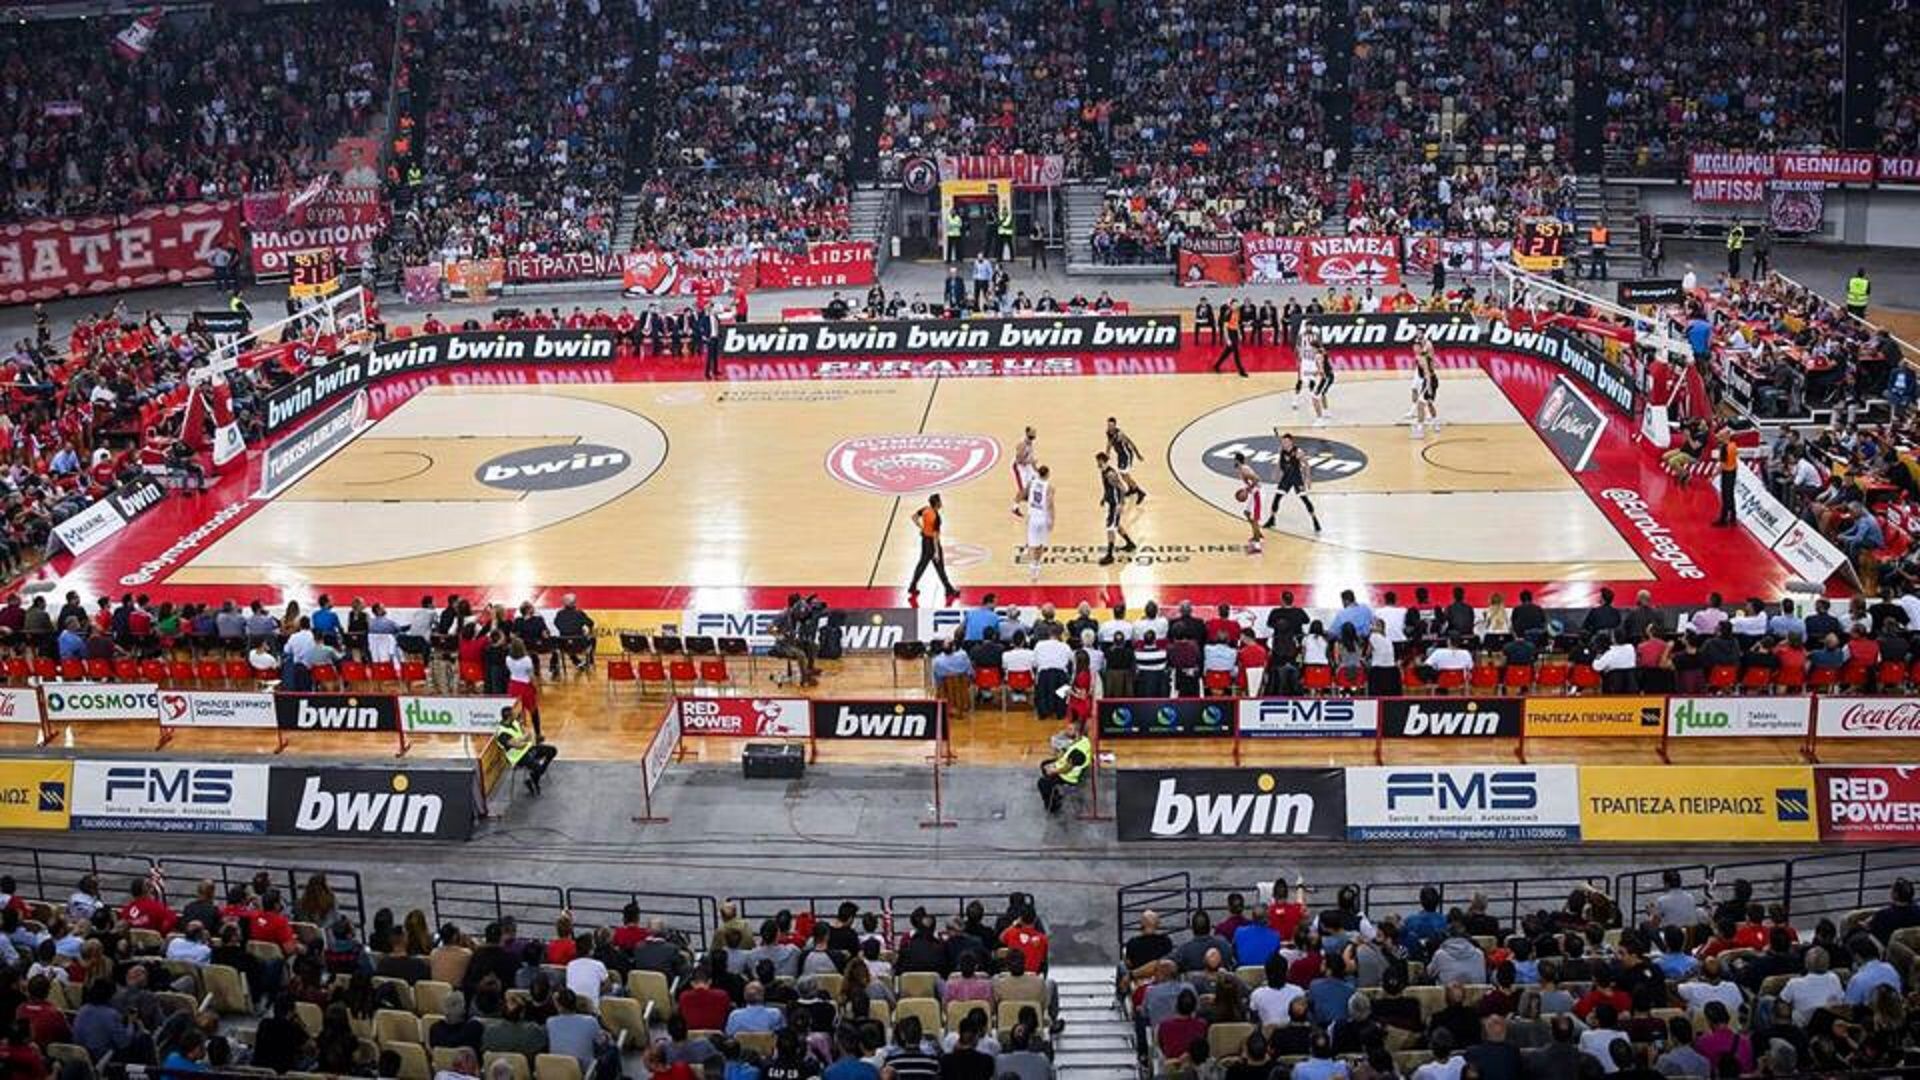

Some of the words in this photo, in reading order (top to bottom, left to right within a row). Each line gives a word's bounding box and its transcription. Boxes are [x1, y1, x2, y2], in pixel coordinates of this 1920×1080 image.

[1784, 157, 1873, 175] ΛΕΩΝΙΔΙΟ
[1693, 180, 1764, 201] AMFISSA
[1309, 238, 1396, 257] NEMEA
[724, 327, 810, 352] bwin
[815, 325, 898, 350] bwin
[907, 323, 990, 348] bwin
[1000, 321, 1083, 347] bwin
[1092, 320, 1178, 345] bwin
[1393, 316, 1481, 343] bwin
[1490, 321, 1559, 358] bwin
[1561, 338, 1596, 383] bwin
[1597, 363, 1633, 411] bwin
[269, 385, 313, 429] bwin
[315, 359, 361, 400] bwin
[367, 337, 438, 377] bwin
[447, 334, 525, 361] bwin
[533, 334, 612, 359] bwin
[482, 451, 624, 482] bwin
[116, 481, 162, 518] bwin
[1600, 486, 1706, 581] @EuroLeague
[67, 693, 159, 710] COSMOTE
[297, 697, 379, 728] bwin
[682, 701, 720, 715] RED
[1259, 701, 1355, 722] FMS
[683, 715, 742, 728] POWER
[835, 703, 927, 737] bwin
[1403, 701, 1500, 735] bwin
[1527, 713, 1580, 723] ΤΡΑΠΕΖΑ
[106, 767, 233, 804] FMS
[1386, 771, 1538, 810] FMS
[1829, 777, 1889, 801] RED
[295, 773, 443, 834] bwin
[1150, 772, 1315, 835] bwin
[1590, 796, 1676, 816] ΤΡΑΠΕΖΑ
[1679, 796, 1766, 815] ΠΕΙΡΑΙΩΣ
[1831, 801, 1920, 823] POWER
